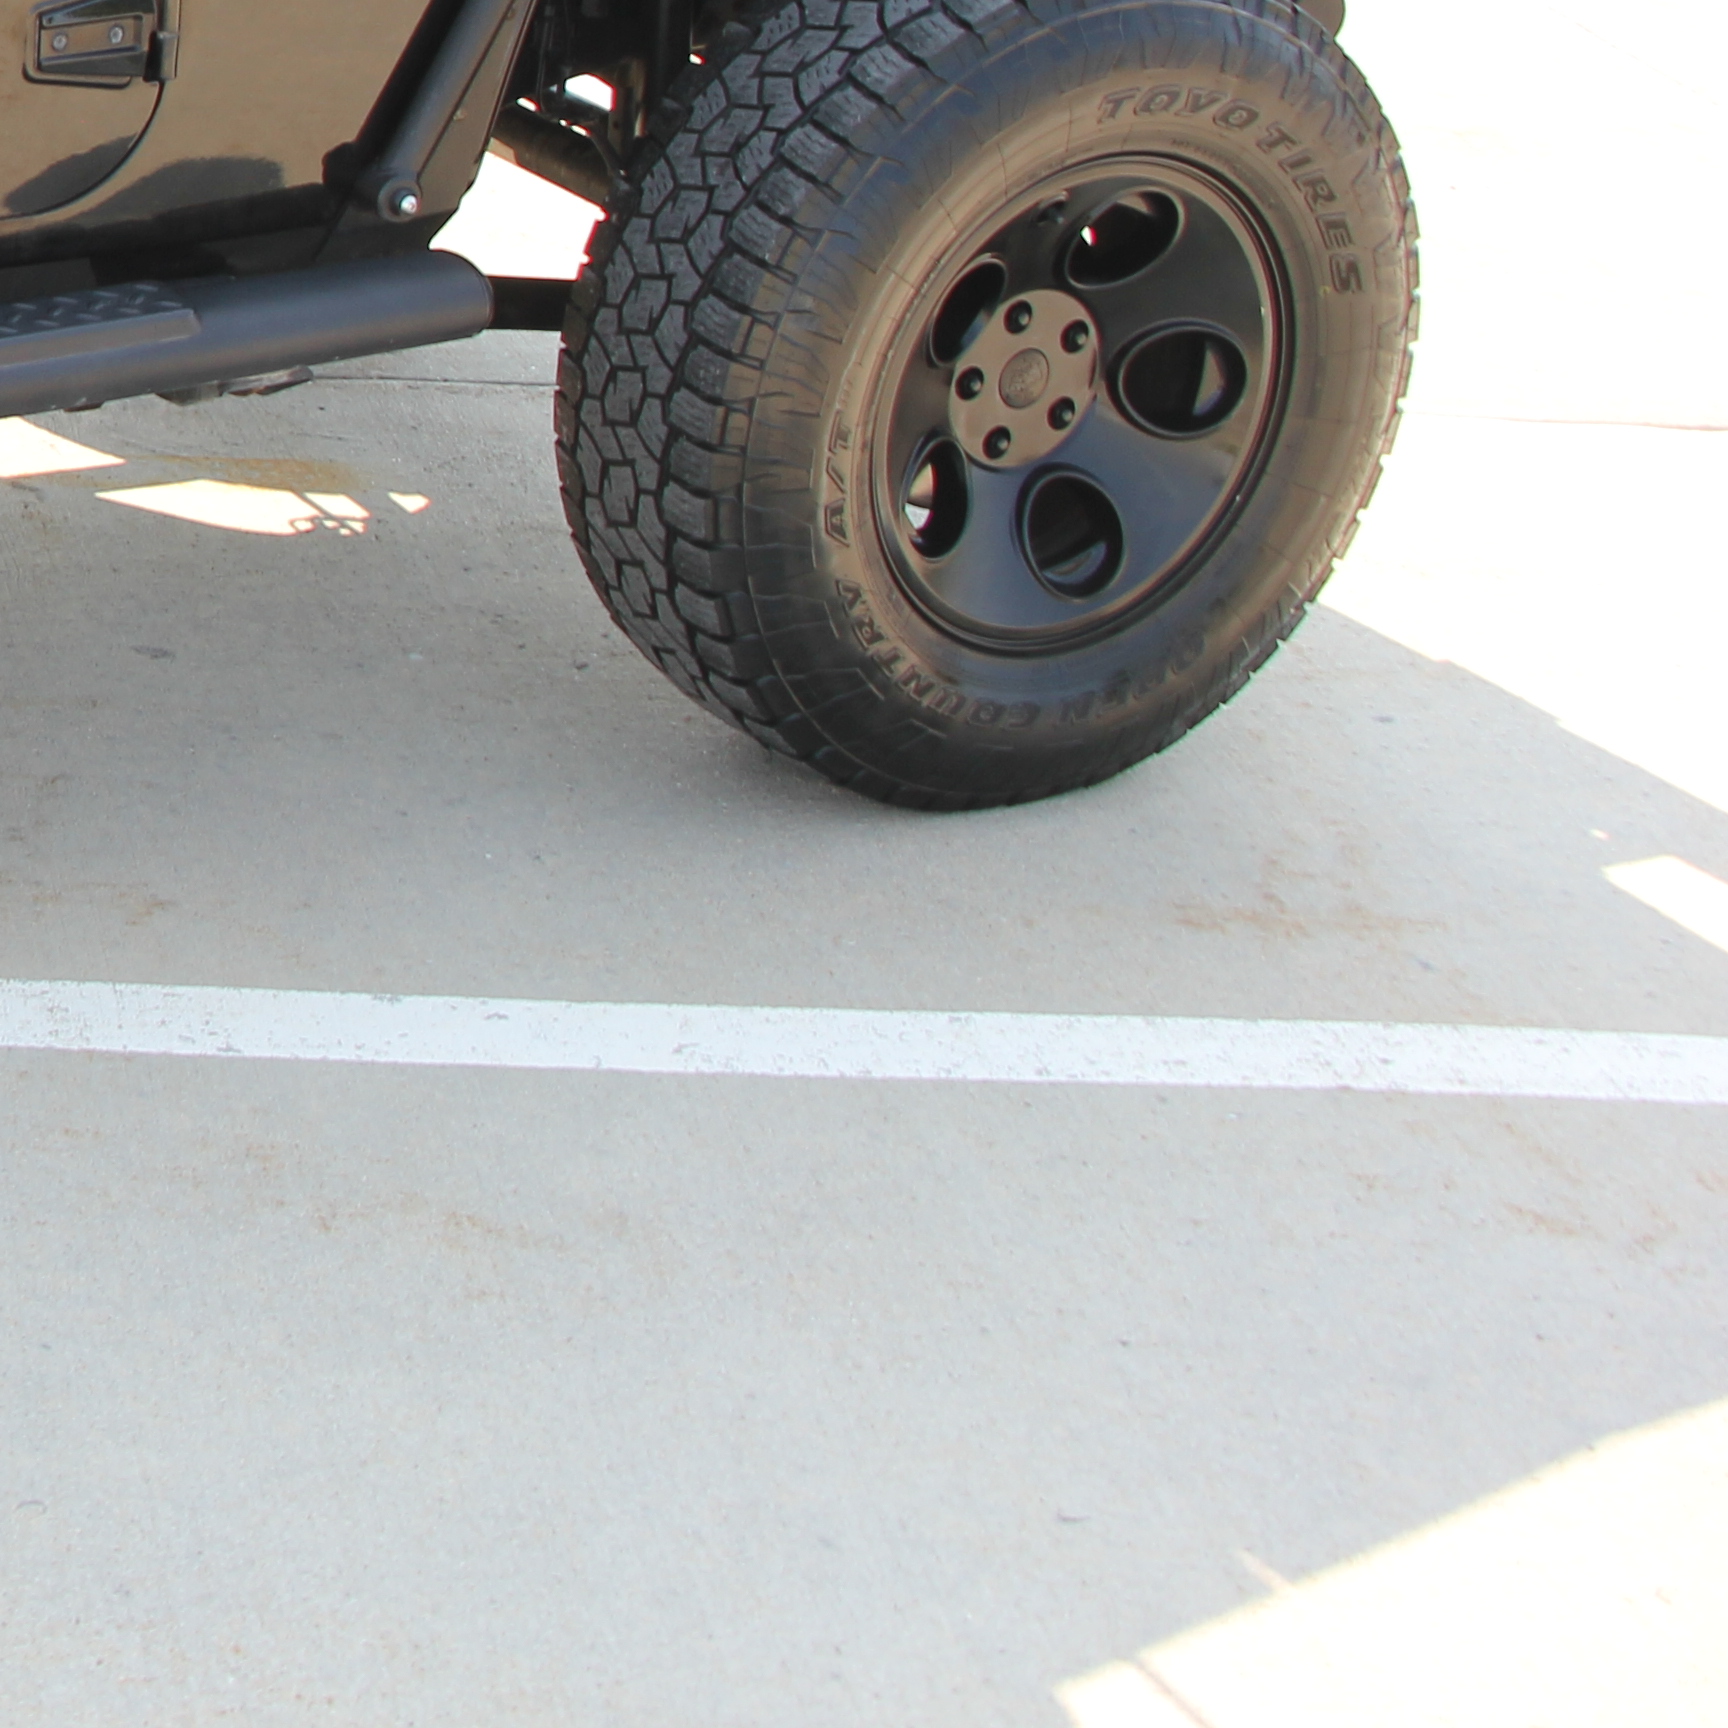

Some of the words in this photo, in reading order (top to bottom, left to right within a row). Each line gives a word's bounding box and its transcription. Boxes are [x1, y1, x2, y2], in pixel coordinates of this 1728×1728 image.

[1096, 84, 1259, 129] TOYO
[1255, 122, 1363, 294] TIRES
[835, 577, 1042, 726] COUNTRY
